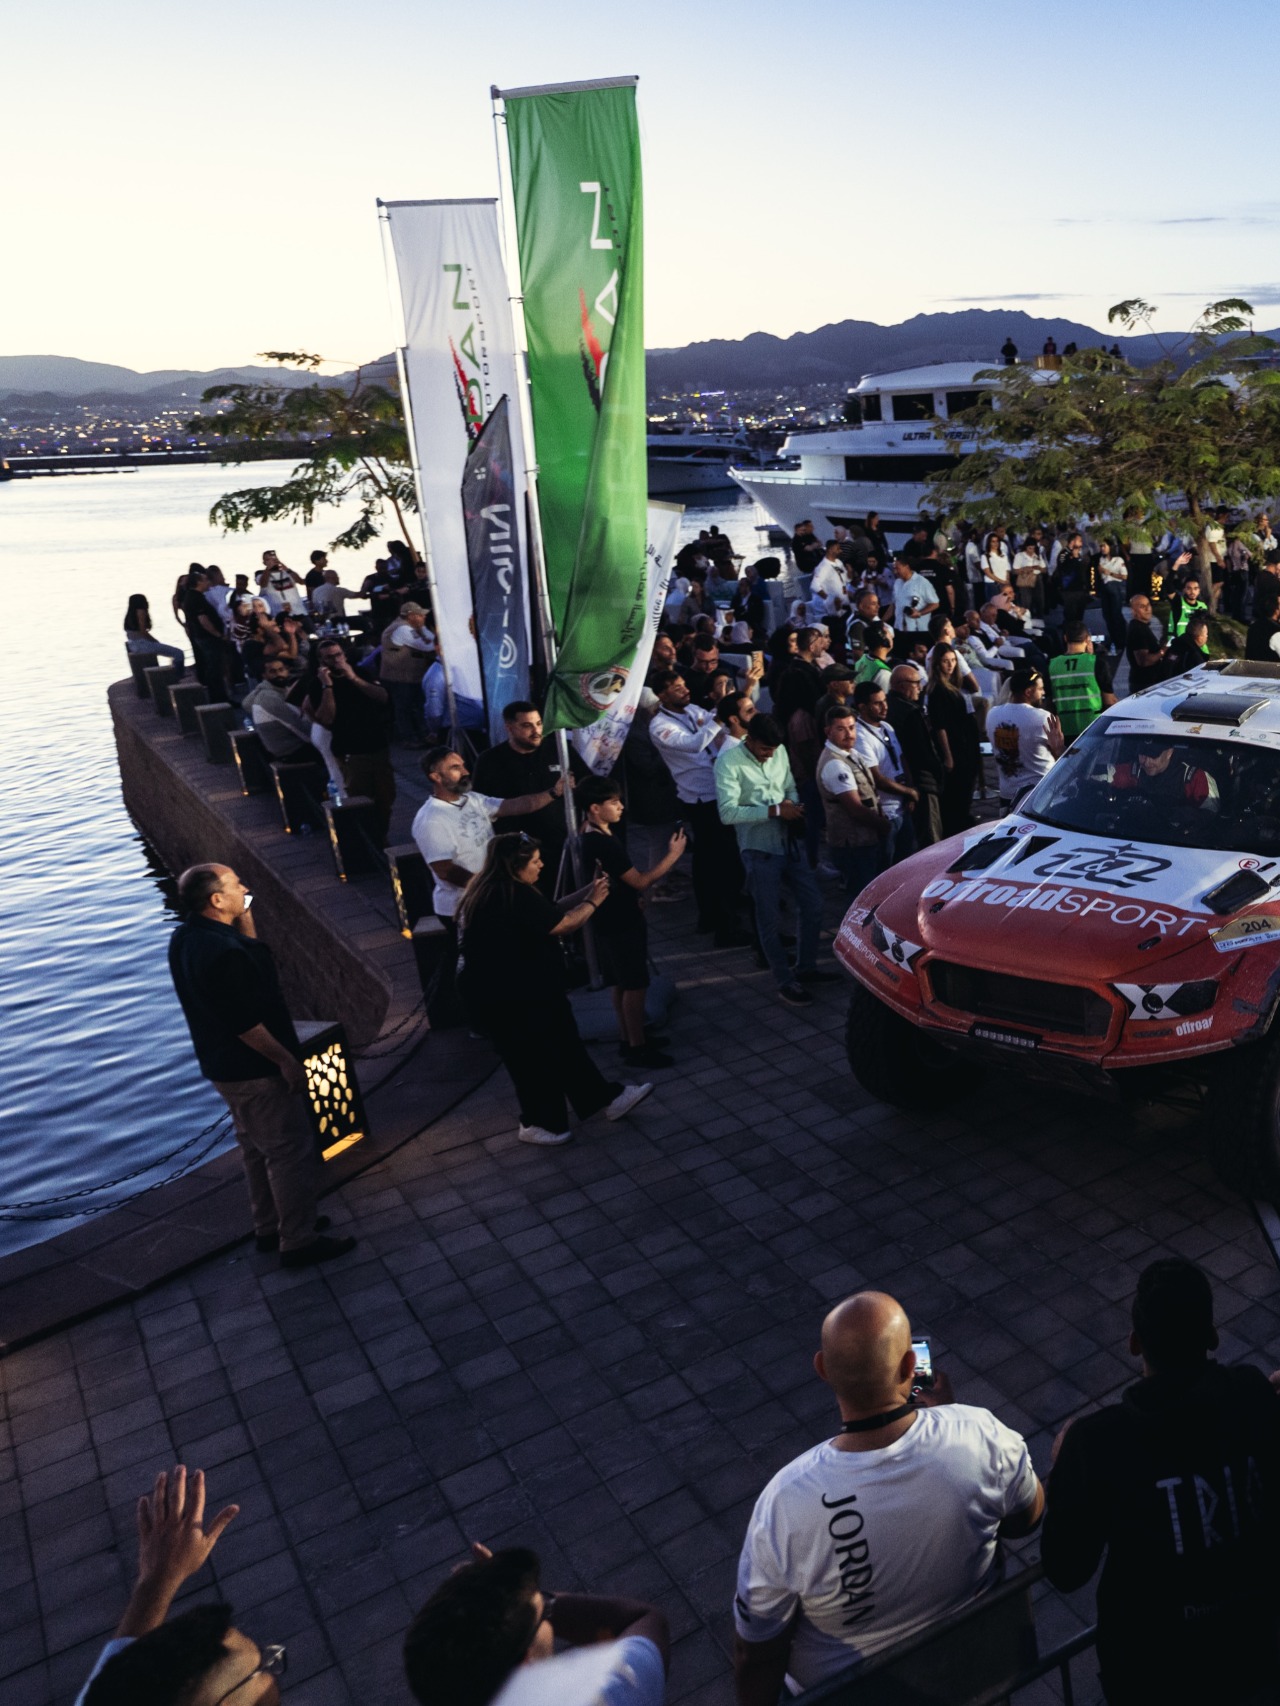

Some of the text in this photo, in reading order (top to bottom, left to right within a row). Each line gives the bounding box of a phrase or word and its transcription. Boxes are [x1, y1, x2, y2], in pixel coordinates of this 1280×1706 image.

[1065, 658, 1078, 672] 17
[922, 879, 1207, 937] offroadSPORT
[1241, 918, 1271, 934] 204
[821, 1492, 875, 1627] JORDAN
